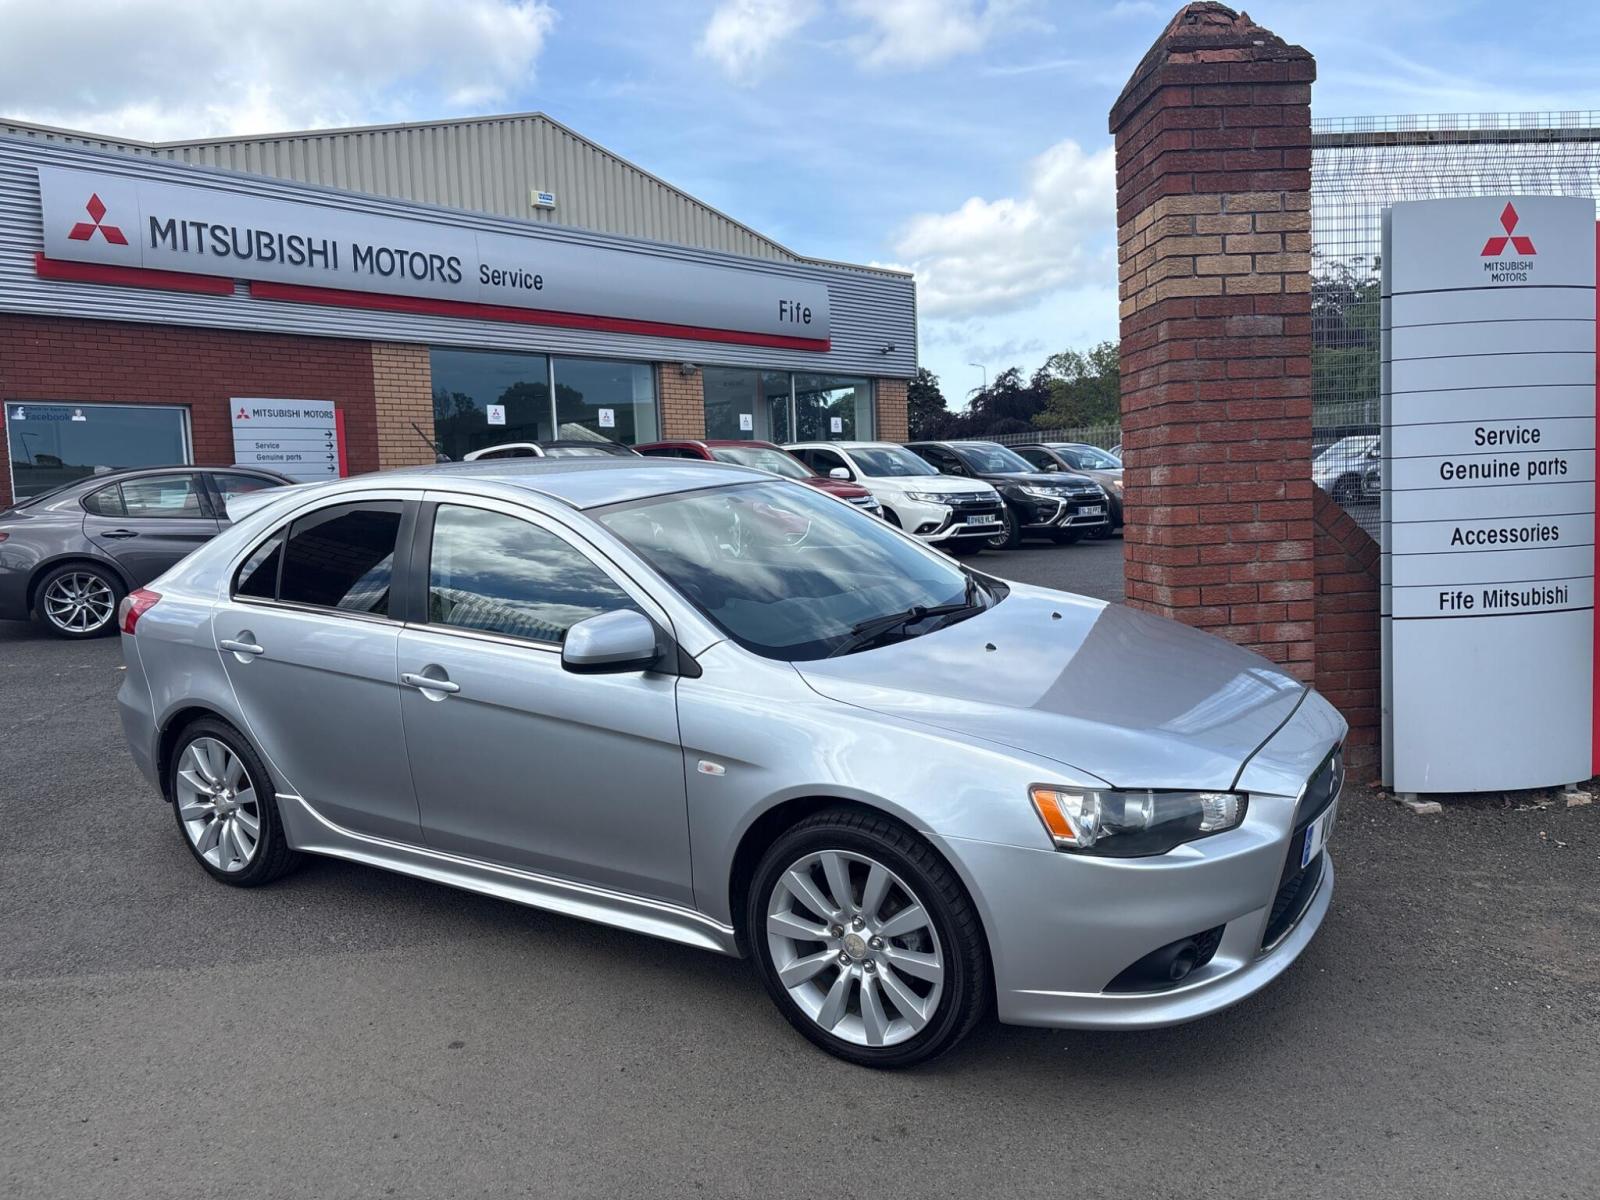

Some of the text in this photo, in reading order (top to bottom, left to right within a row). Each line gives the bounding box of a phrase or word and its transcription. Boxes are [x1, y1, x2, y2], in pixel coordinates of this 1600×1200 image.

[150, 216, 543, 290] MITSUBISHI MOTORS Service
[1484, 261, 1534, 271] MITSUBISHI
[1491, 272, 1527, 282] MOTORS
[779, 300, 812, 324] Fife
[252, 409, 334, 419] MITSUBISHI MOTORS
[1474, 425, 1541, 446] Service
[256, 453, 302, 461] Genuine parts
[1440, 457, 1567, 480] Genuine parts
[1451, 523, 1559, 546] Accessories
[1439, 585, 1568, 610] Fife Mitsubishi
